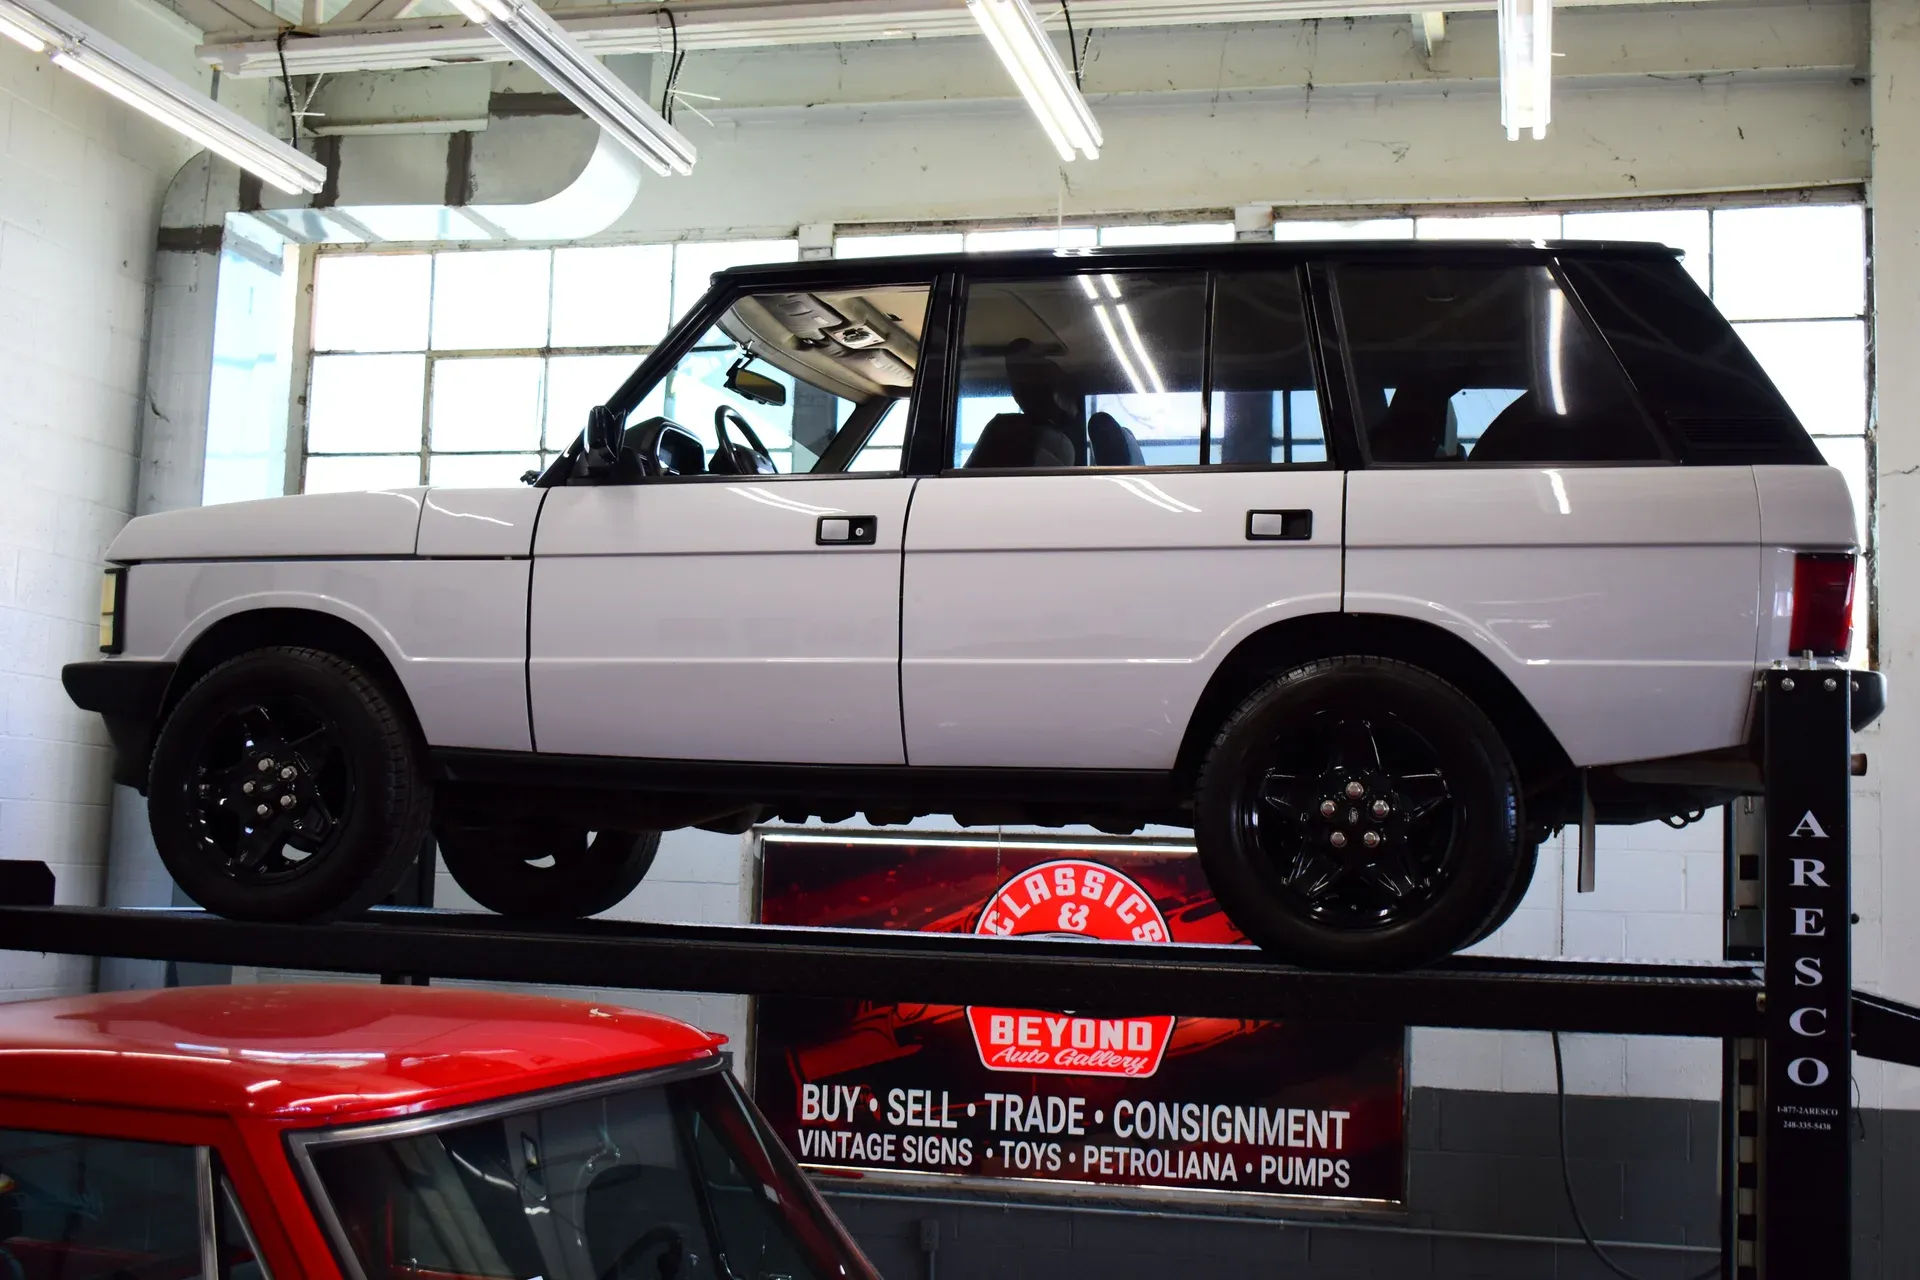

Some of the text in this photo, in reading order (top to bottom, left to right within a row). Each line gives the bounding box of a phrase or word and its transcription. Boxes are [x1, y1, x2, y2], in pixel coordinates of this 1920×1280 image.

[984, 867, 1163, 942] CLASSICS
[1057, 901, 1090, 932] &
[1787, 810, 1829, 1087] ARESCO
[989, 1014, 1153, 1052] BEYOND
[991, 1045, 1149, 1076] Auto Gallery
[802, 1083, 1350, 1150] BUY SELL TRADE CONSIGNMENT
[797, 1128, 1350, 1189] VINTAGE SIGNS TOYS PETROLIANA PUMPS
